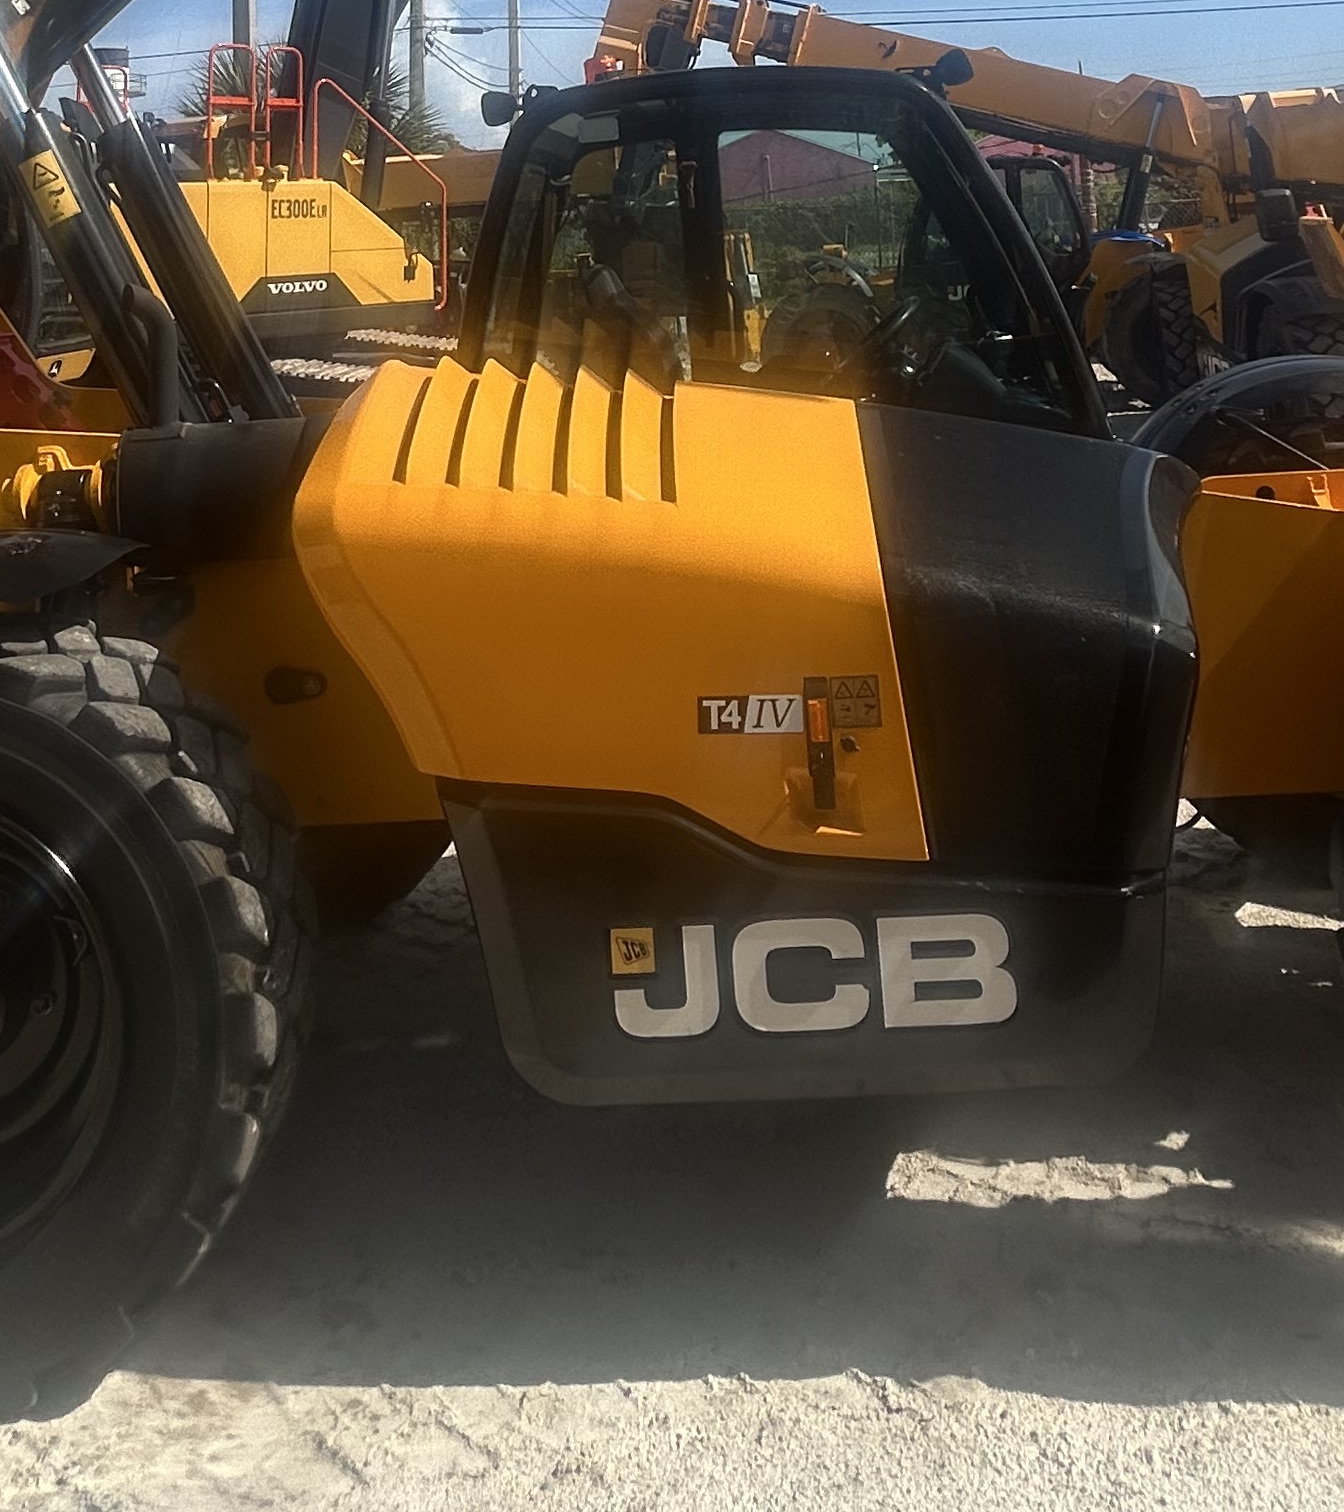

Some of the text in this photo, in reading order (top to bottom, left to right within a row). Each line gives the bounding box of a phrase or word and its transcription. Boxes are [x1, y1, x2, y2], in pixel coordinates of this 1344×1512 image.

[267, 280, 328, 294] VOLVO
[622, 940, 647, 962] JCB
[614, 913, 1018, 1038] JCB
